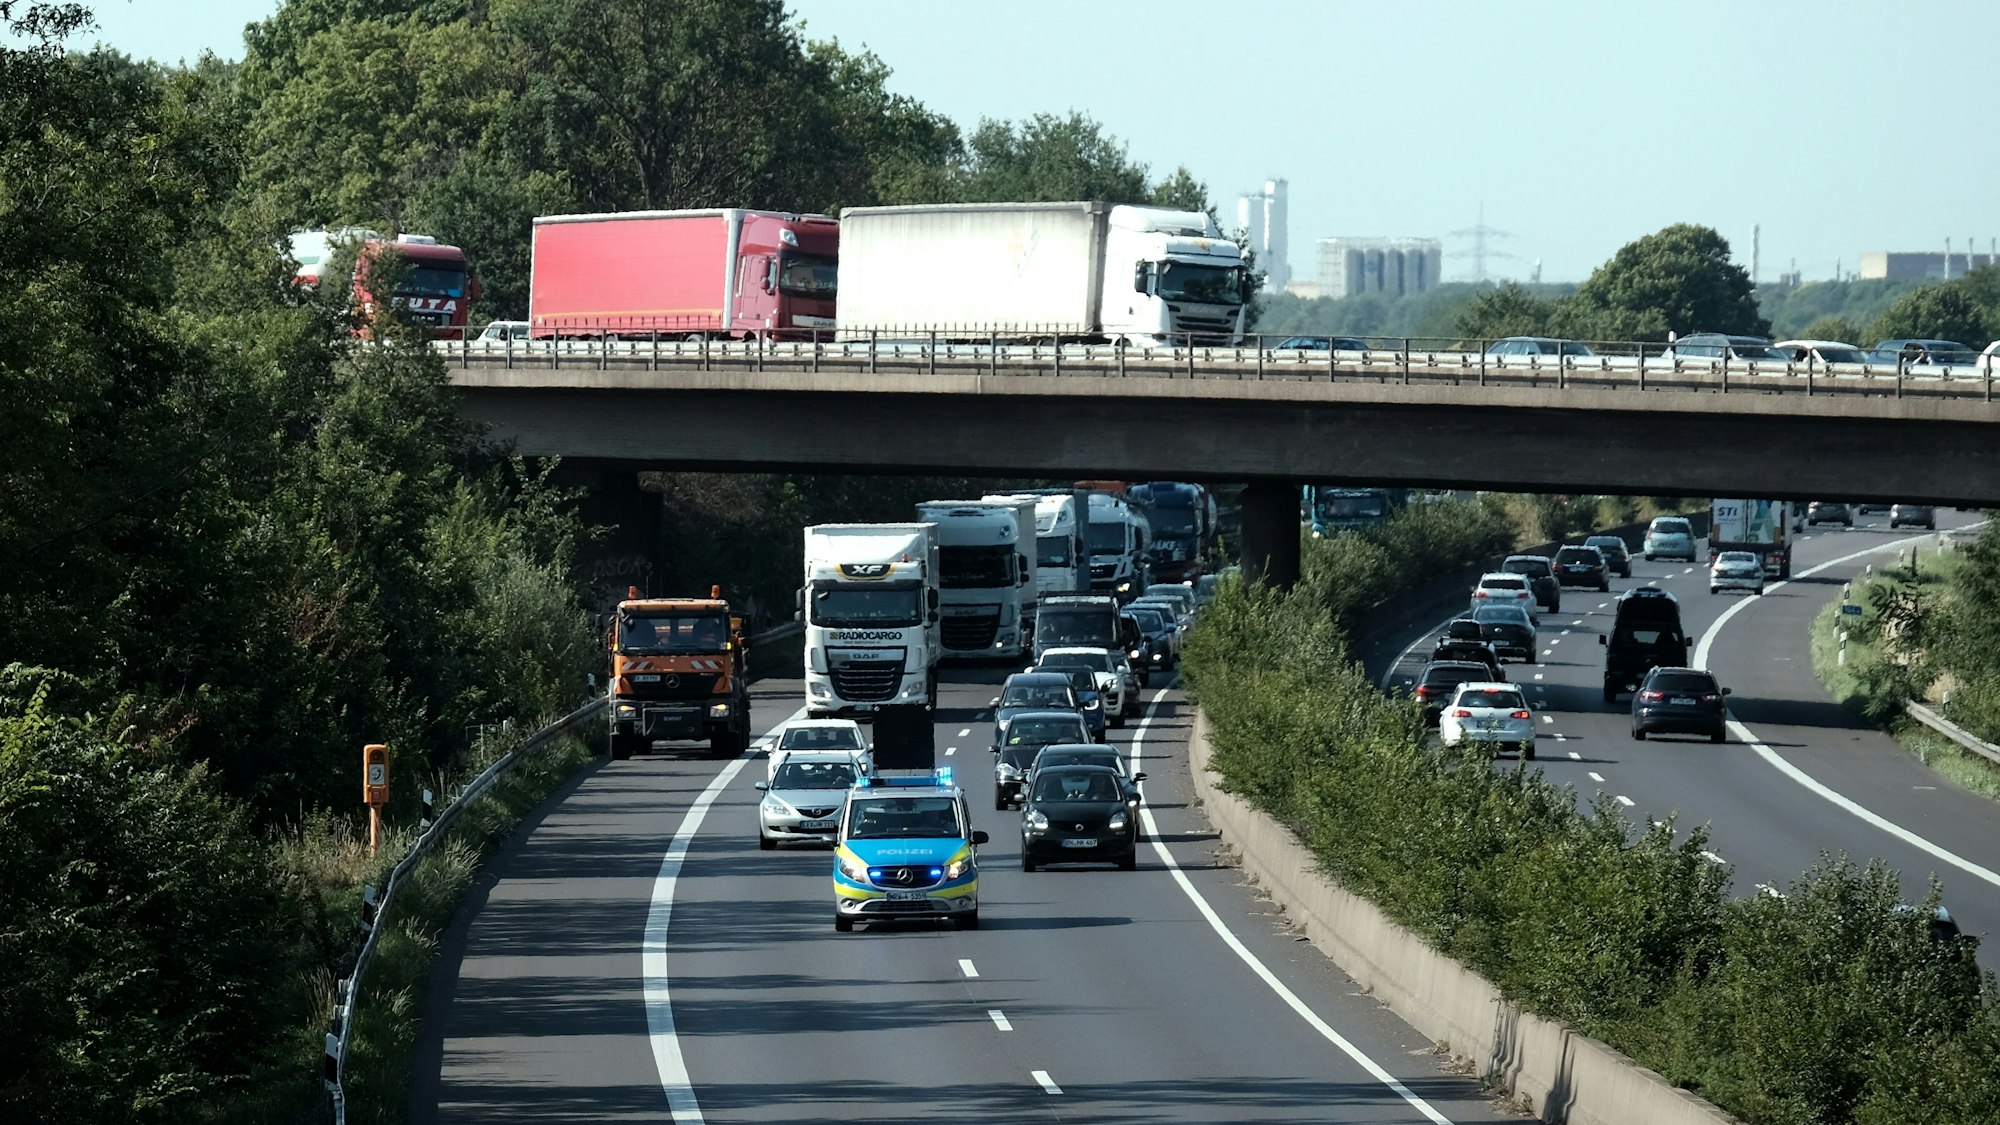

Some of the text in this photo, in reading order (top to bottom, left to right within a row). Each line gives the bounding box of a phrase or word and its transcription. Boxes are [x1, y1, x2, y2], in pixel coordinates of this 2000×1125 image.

[851, 565, 883, 575] XF
[838, 631, 903, 640] RADIOCARGO
[876, 848, 933, 856] POLIZEI
